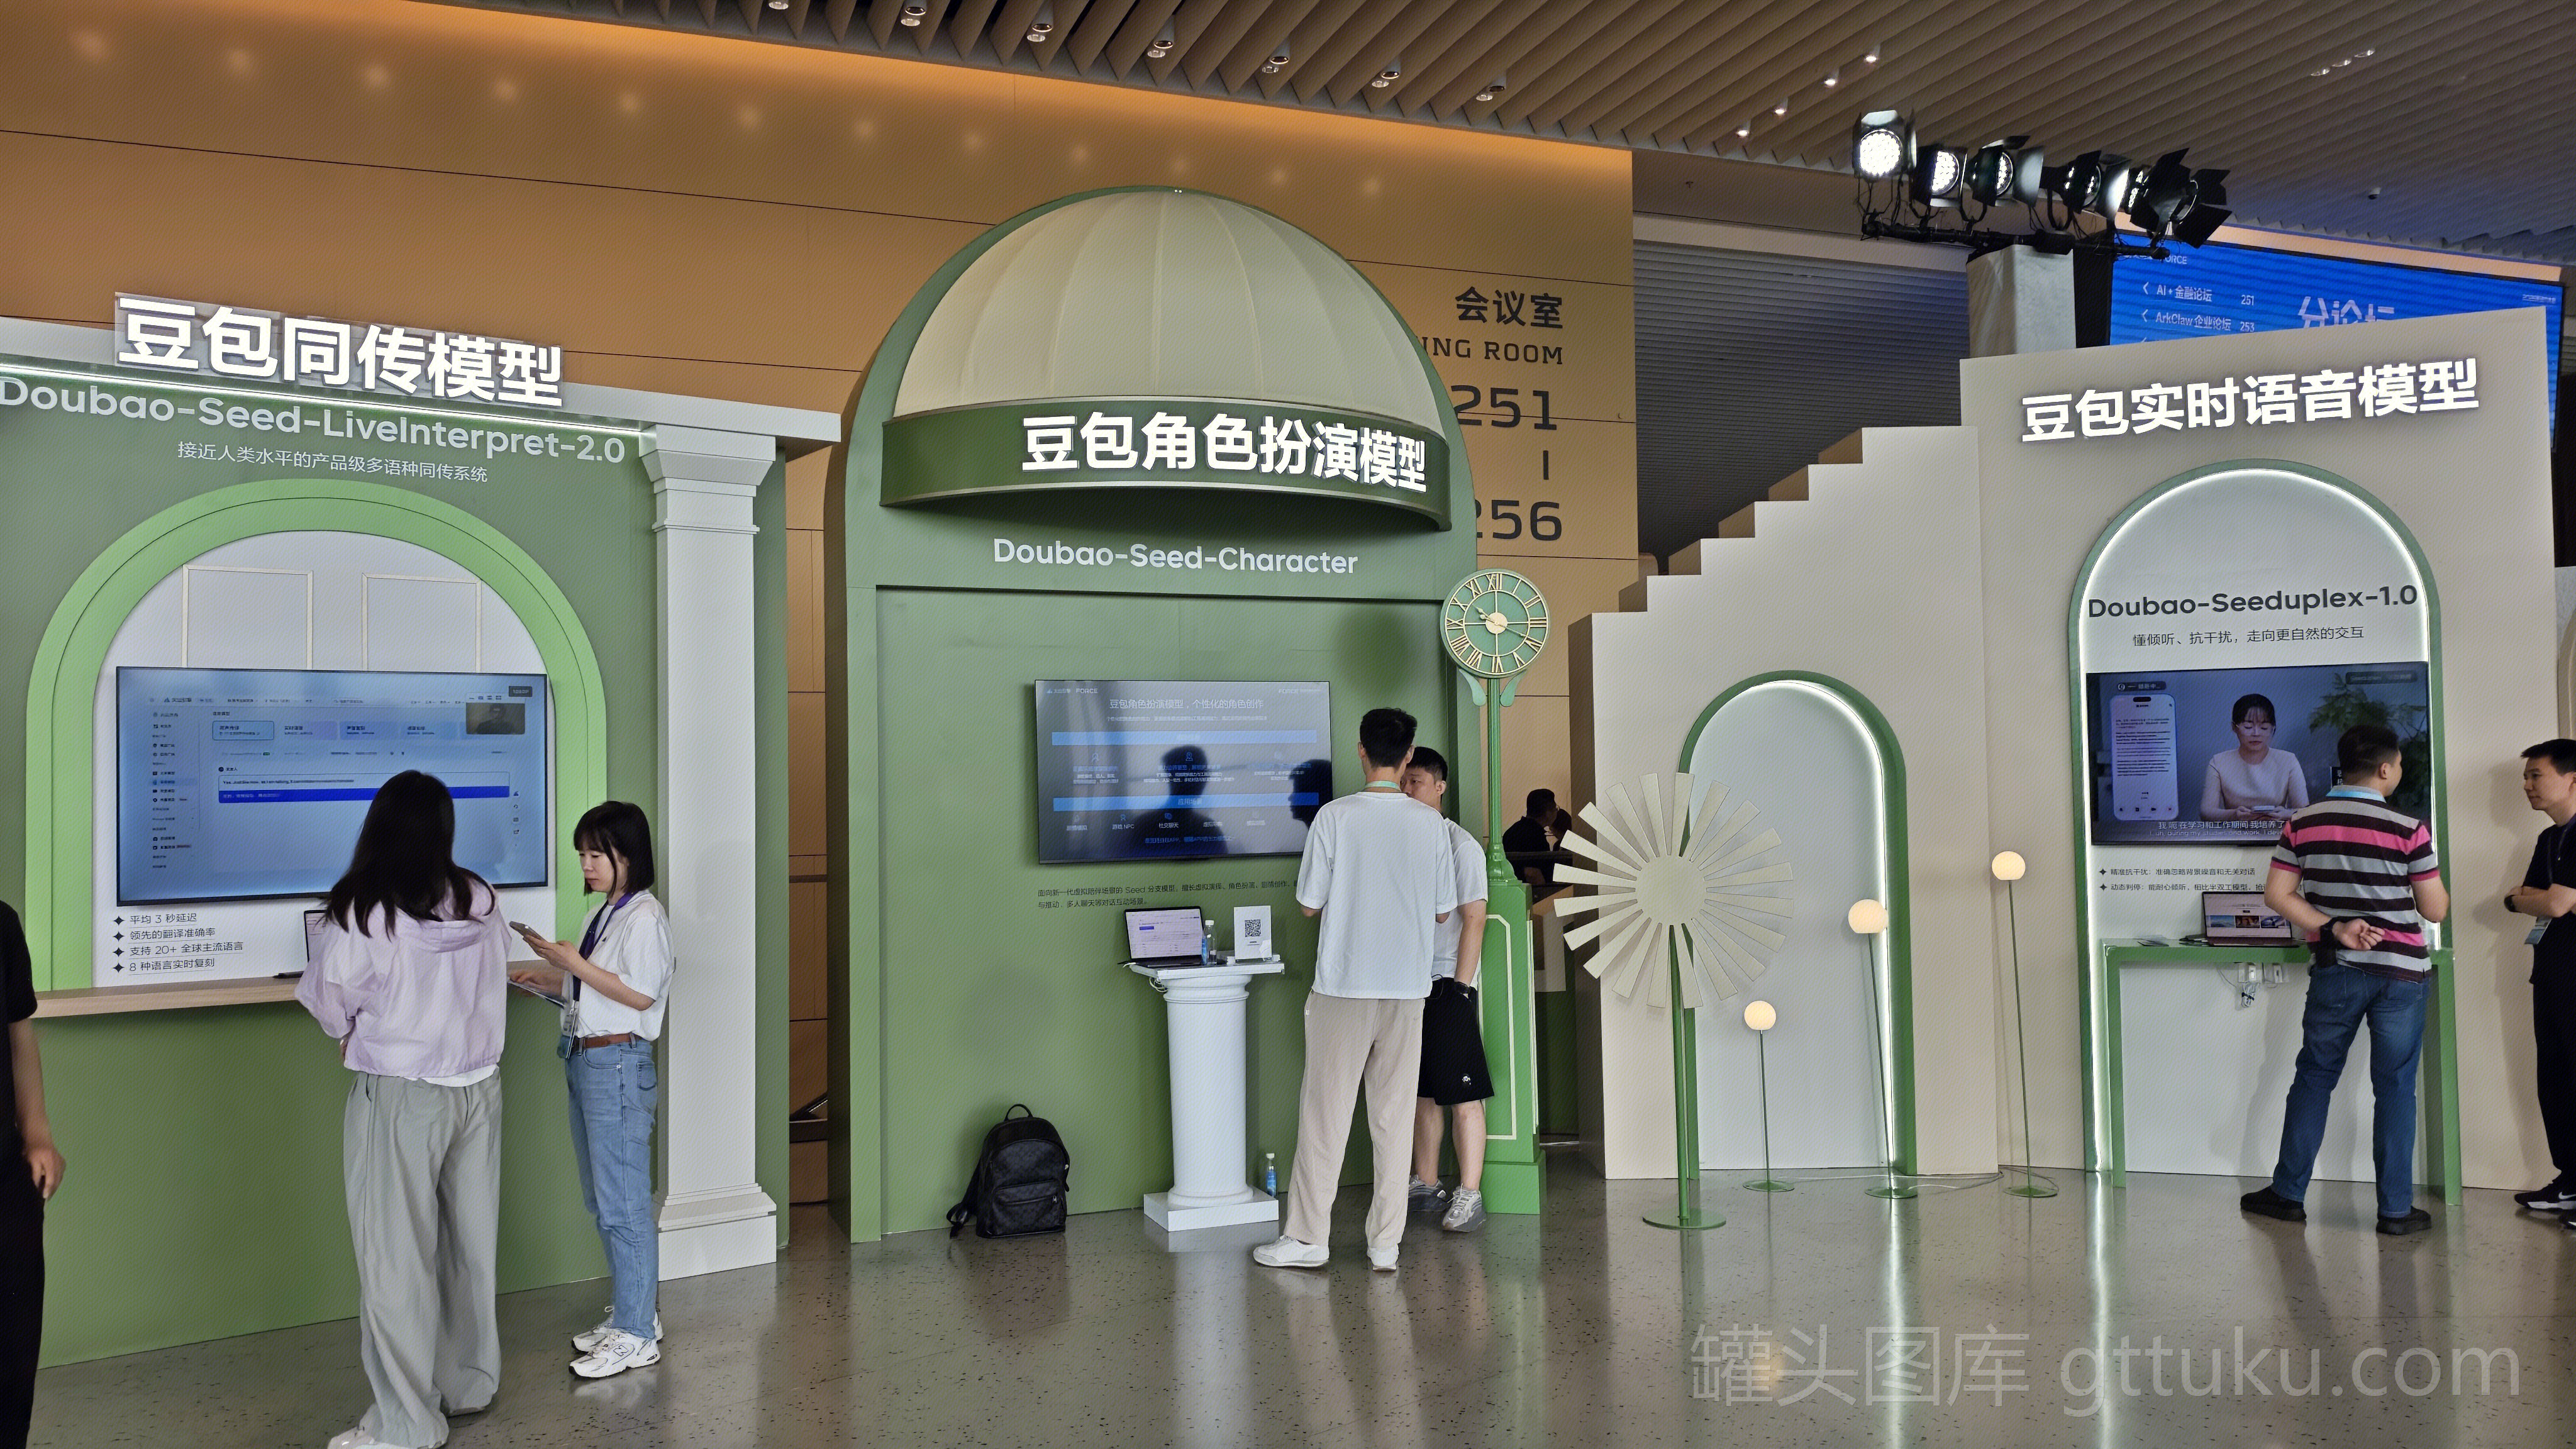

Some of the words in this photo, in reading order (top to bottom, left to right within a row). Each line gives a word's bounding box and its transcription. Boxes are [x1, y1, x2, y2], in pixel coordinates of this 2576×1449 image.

[2165, 255, 2187, 265] ORCE
[2157, 284, 2166, 296] AI
[2175, 285, 2212, 302] 金融论坛
[2241, 294, 2255, 306] 251
[1455, 286, 1563, 329] 会议室
[2155, 311, 2193, 326] ArkClaw
[2194, 314, 2231, 331] 企业论坛
[2240, 321, 2255, 332] 253
[118, 297, 562, 408] 豆包同传模型
[1419, 336, 1470, 358] ING
[1484, 341, 1563, 365] ROOM
[1451, 384, 1557, 431] 251
[2021, 357, 2480, 443] 豆包实时语音模型
[0, 377, 625, 464] Doubao-Seed-LiveInterpret-2.0
[177, 441, 488, 483] 接近人类水平的产品级多语种同传系统
[1021, 411, 1427, 492] 豆包角色扮演模型
[1475, 499, 1563, 541] 56
[994, 538, 1358, 575] Doubao-Seed-Character
[2089, 585, 2418, 618] Doubao-Seeduplex-1.0
[2133, 626, 2364, 647] 懂倾听、抗干扰，走向更自然的交互
[1109, 699, 1263, 709] 豆包角色扮演模型，个性化的角色创作
[2159, 821, 2167, 829] 我
[2180, 821, 2248, 829] 在学习和工作期间
[2111, 868, 2255, 876] 精准抗干扰：准确忽略背景噪音和无关对话
[1038, 887, 1123, 897] 面向新一代虚拟陪伴场景的
[130, 915, 151, 924] 平均
[156, 915, 162, 923] 3
[166, 913, 197, 923] 秒延迟
[130, 928, 216, 940] 领先的翻译准确率
[130, 947, 151, 956] 支持
[155, 945, 177, 955] 20+
[181, 941, 243, 953] 全球主流语言
[130, 963, 136, 972] 8
[140, 958, 215, 971] 种语言实时复刻
